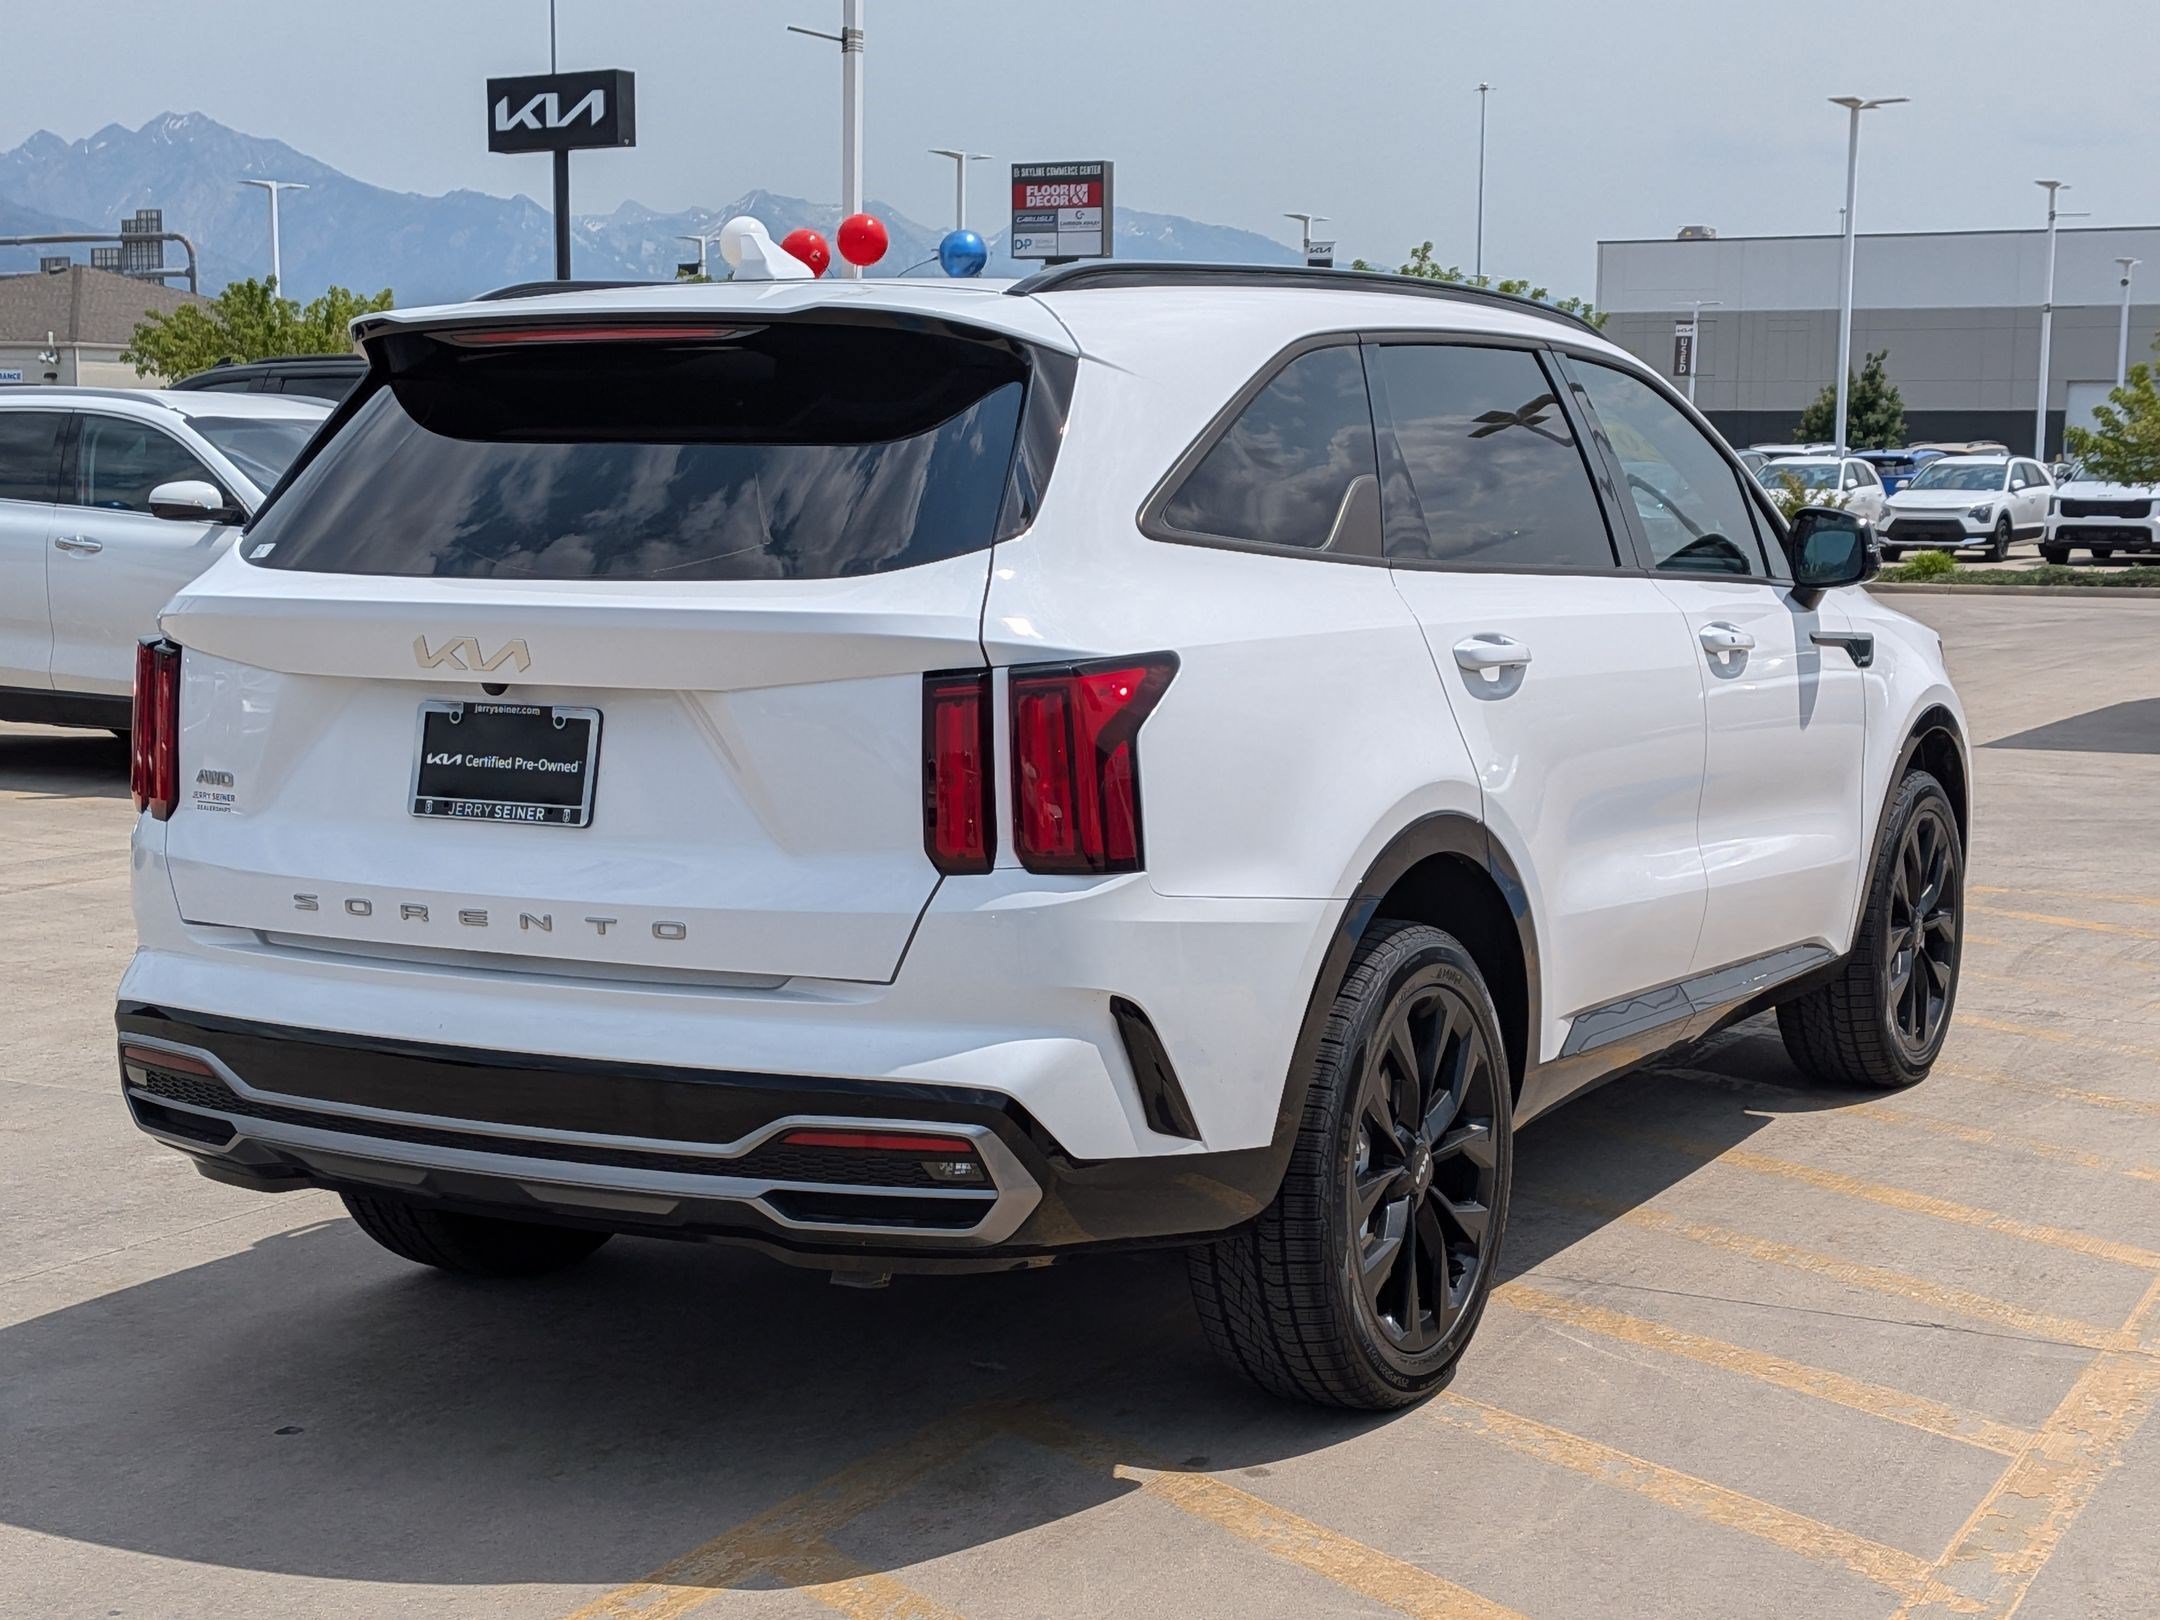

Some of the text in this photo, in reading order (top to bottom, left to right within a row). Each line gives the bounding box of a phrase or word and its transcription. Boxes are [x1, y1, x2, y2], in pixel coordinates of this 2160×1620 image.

[495, 89, 604, 131] KIA
[1026, 185, 1069, 197] FLOOR
[1026, 196, 1069, 207] DECOR
[1679, 338, 1688, 373] USED
[413, 635, 531, 673] KIA
[475, 703, 541, 716] jerryseiner.com
[426, 753, 579, 773] KIA Certified Pre-Owned
[196, 769, 234, 787] AWD
[448, 802, 492, 818] JERRY
[494, 805, 545, 821] SEINER
[294, 893, 687, 940] SORENTO
